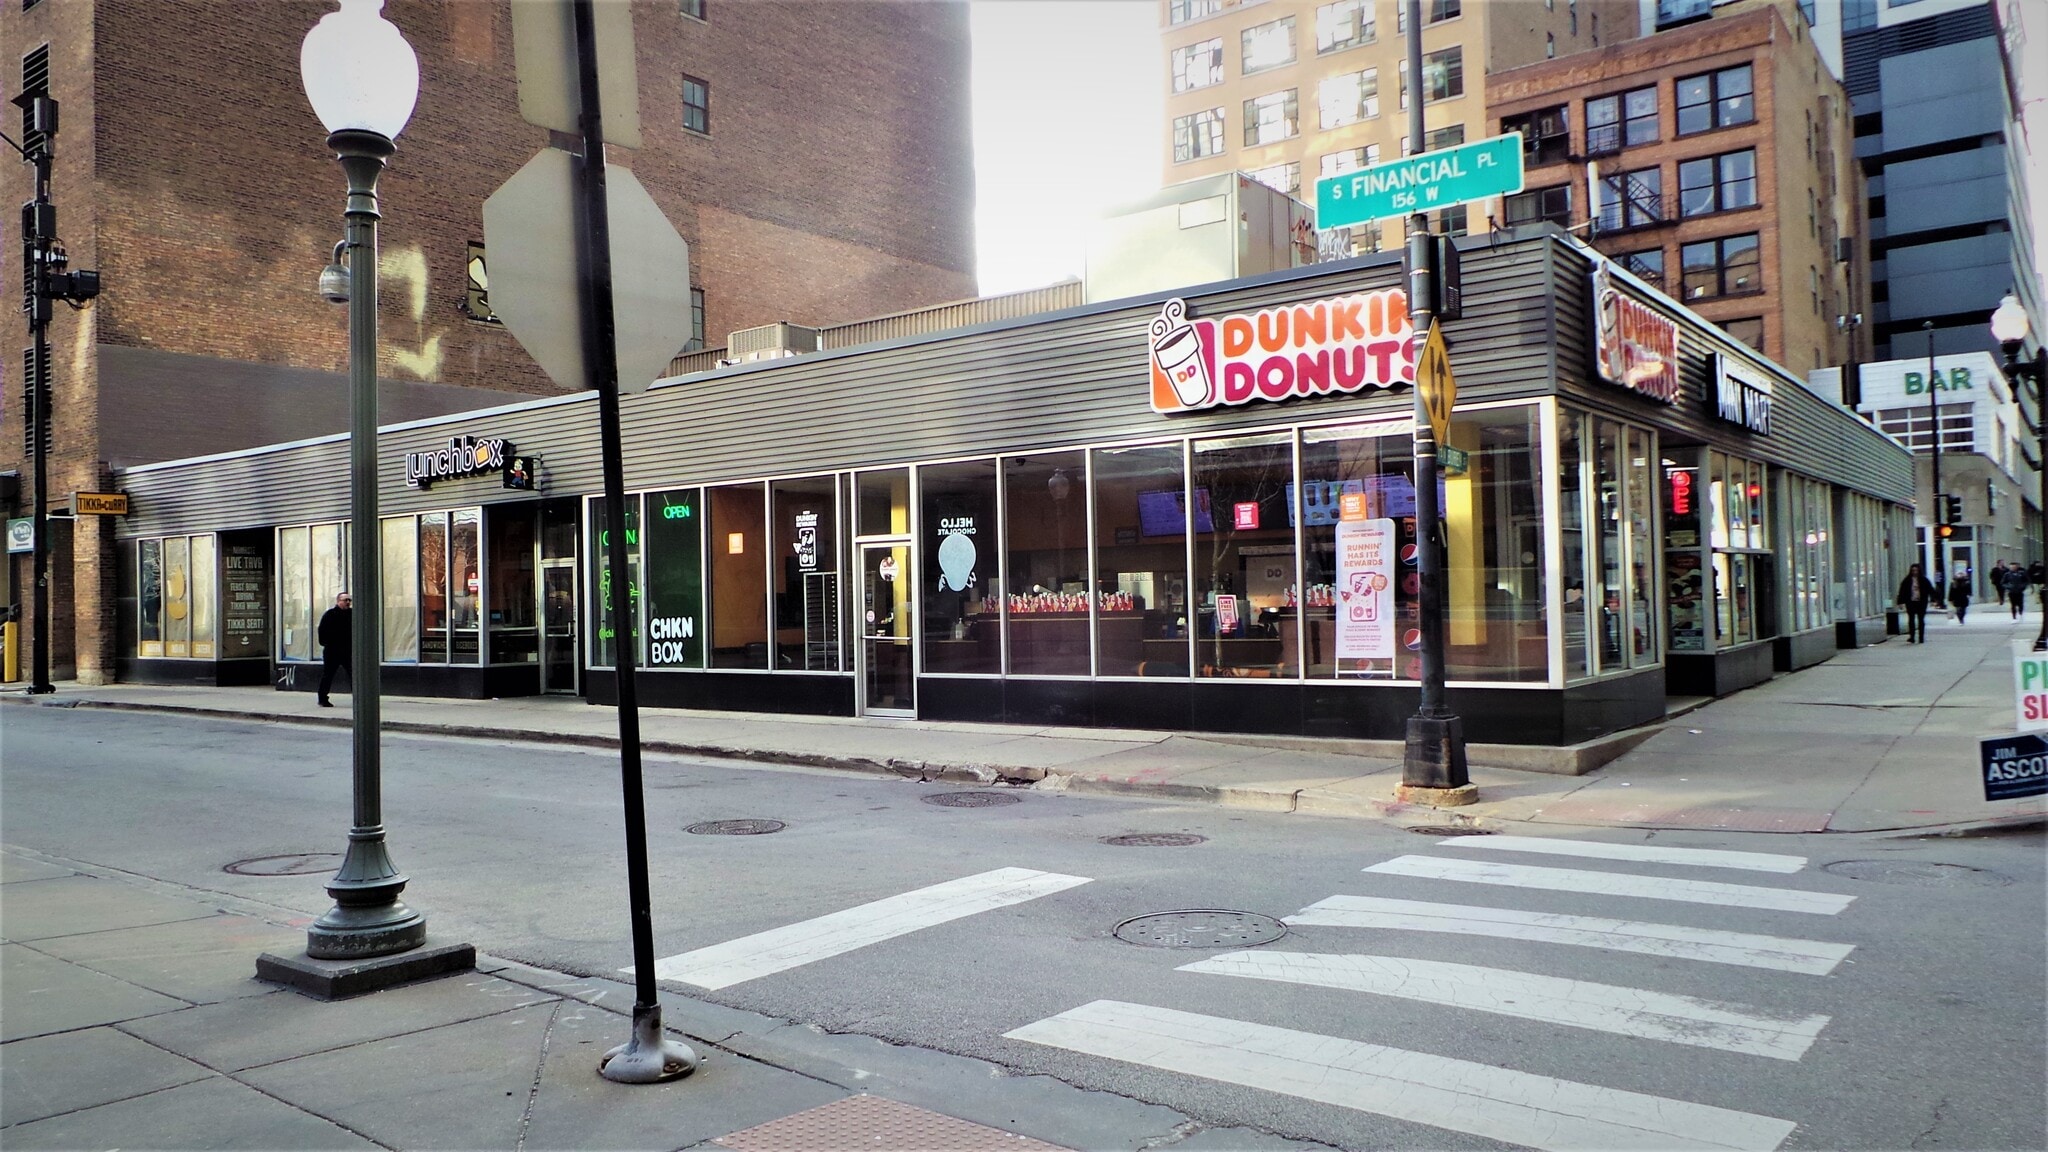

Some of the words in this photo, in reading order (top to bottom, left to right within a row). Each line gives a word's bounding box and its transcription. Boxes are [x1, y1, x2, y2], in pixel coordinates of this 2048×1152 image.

[1332, 184, 1343, 200] S
[1351, 156, 1467, 199] FINANCIAL
[1477, 152, 1498, 169] PL
[1391, 192, 1417, 209] 156
[1426, 186, 1439, 202] W
[1904, 367, 1973, 396] BAR
[77, 497, 101, 511] TIKKA
[663, 505, 690, 519] OPEN
[1347, 542, 1382, 551] RUNNIN'
[226, 556, 242, 569] LIVE
[1344, 559, 1383, 568] REWARDS
[650, 616, 694, 640] CHKN
[651, 641, 684, 664] BOX
[1992, 747, 2017, 761] JIM
